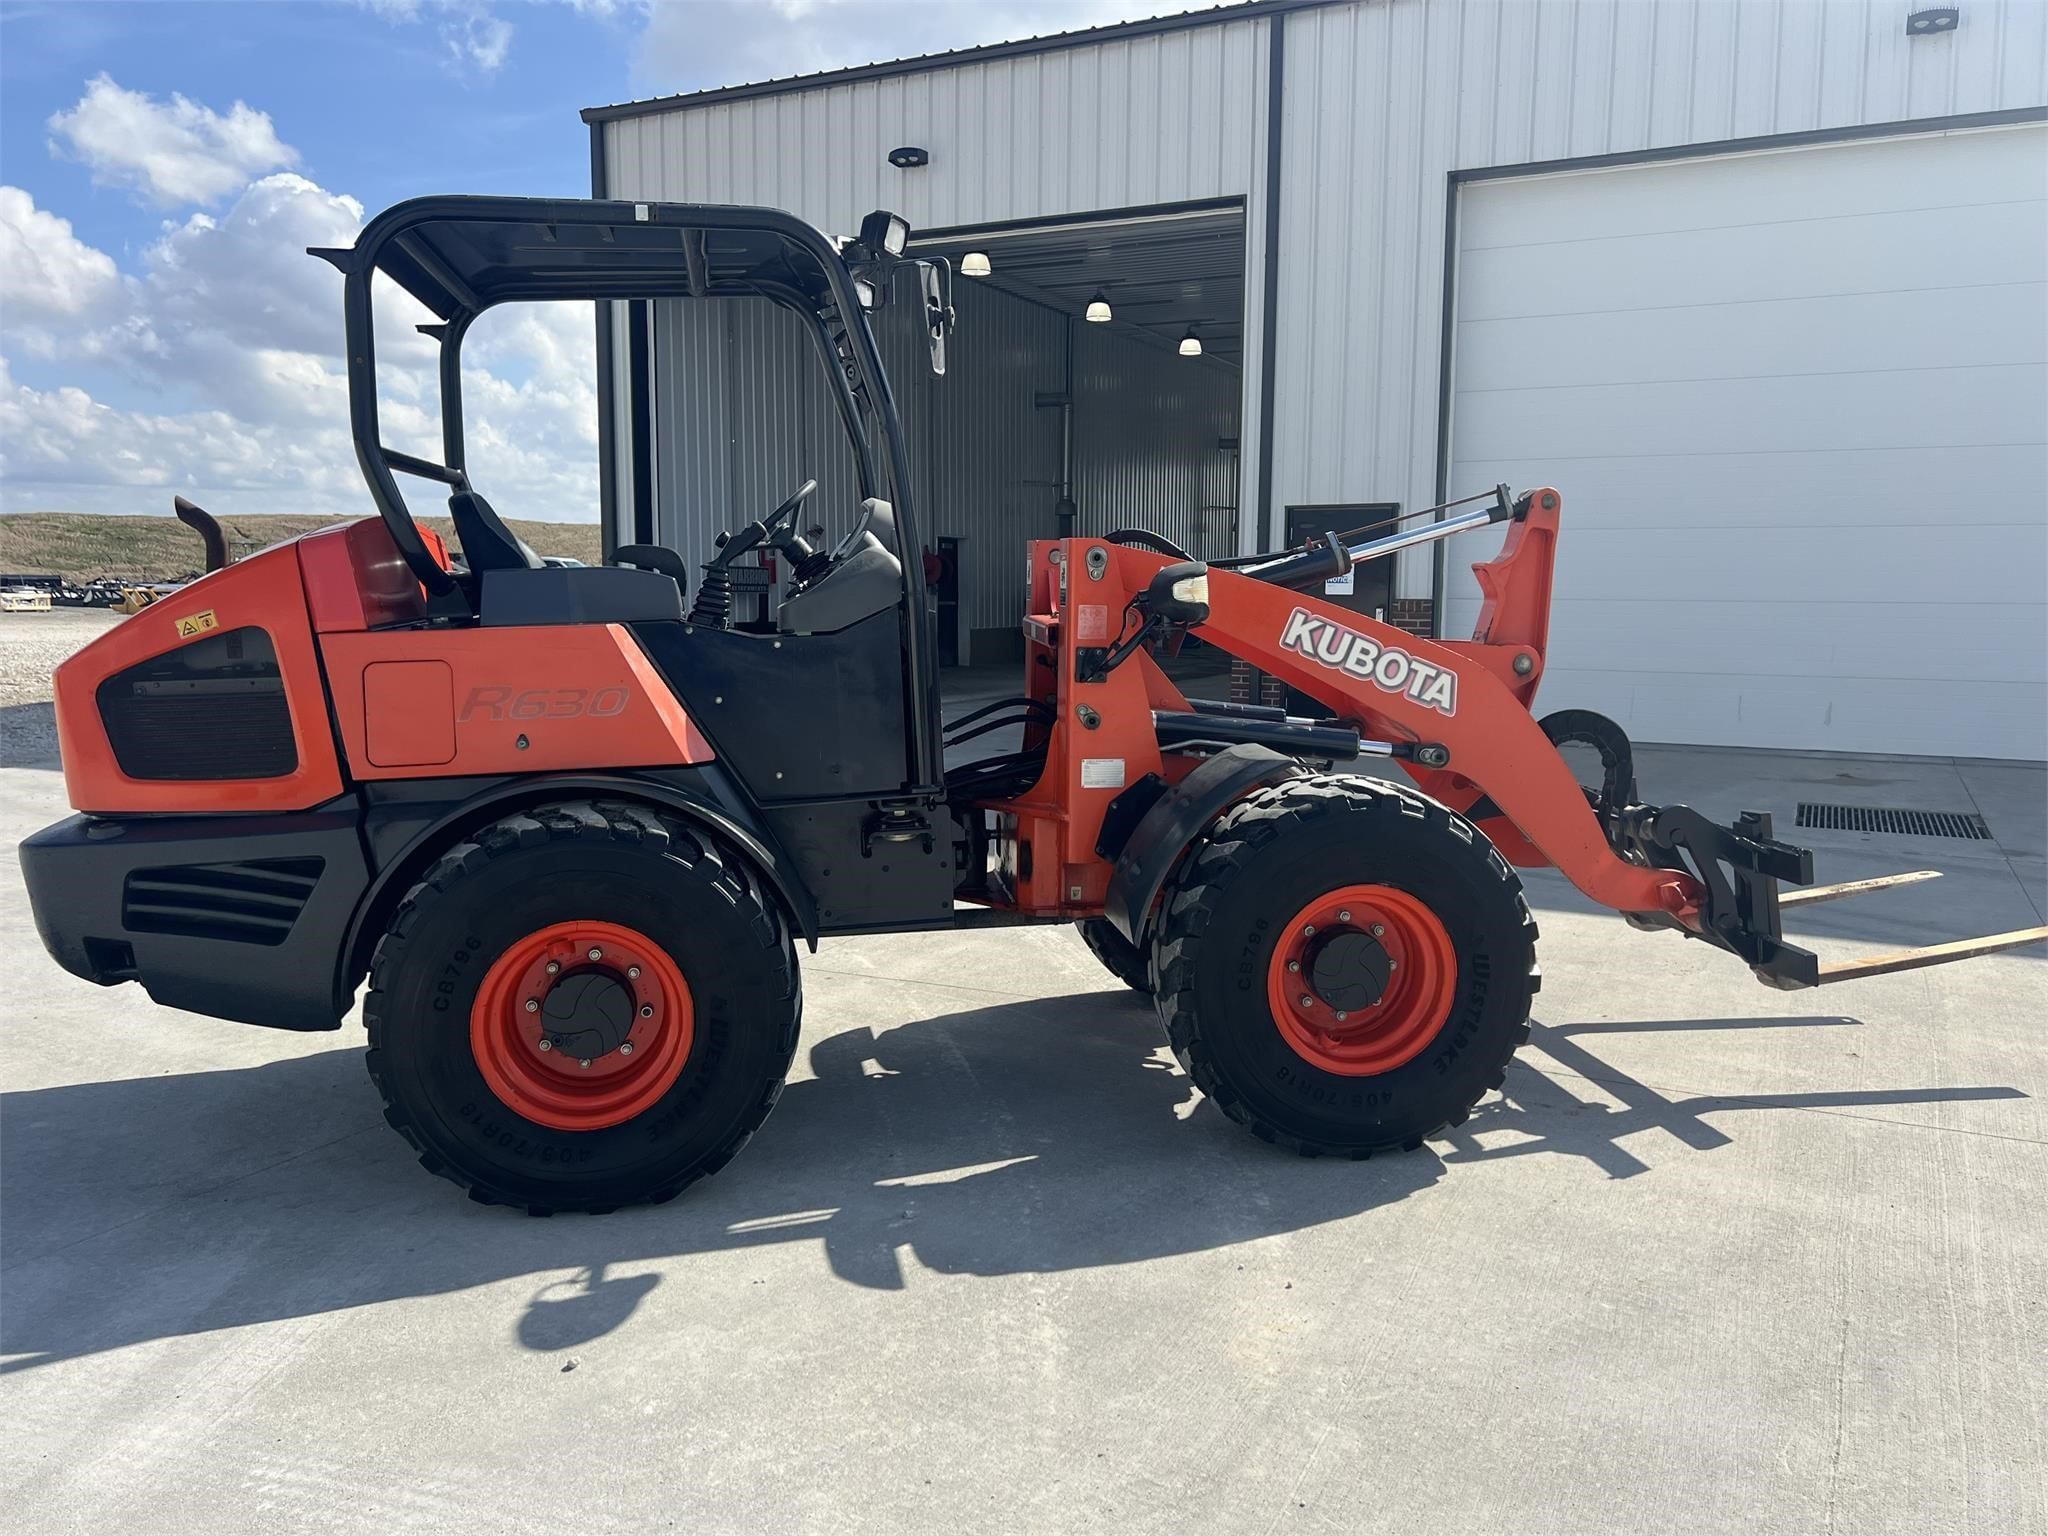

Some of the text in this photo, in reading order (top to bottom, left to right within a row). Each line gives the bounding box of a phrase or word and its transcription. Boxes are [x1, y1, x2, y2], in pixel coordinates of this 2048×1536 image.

[1282, 610, 1455, 712] KUBOTA
[456, 685, 631, 723] R630
[433, 936, 482, 1012] CB796
[1237, 917, 1269, 991] CB796
[1432, 952, 1491, 1076] WESTLAKE
